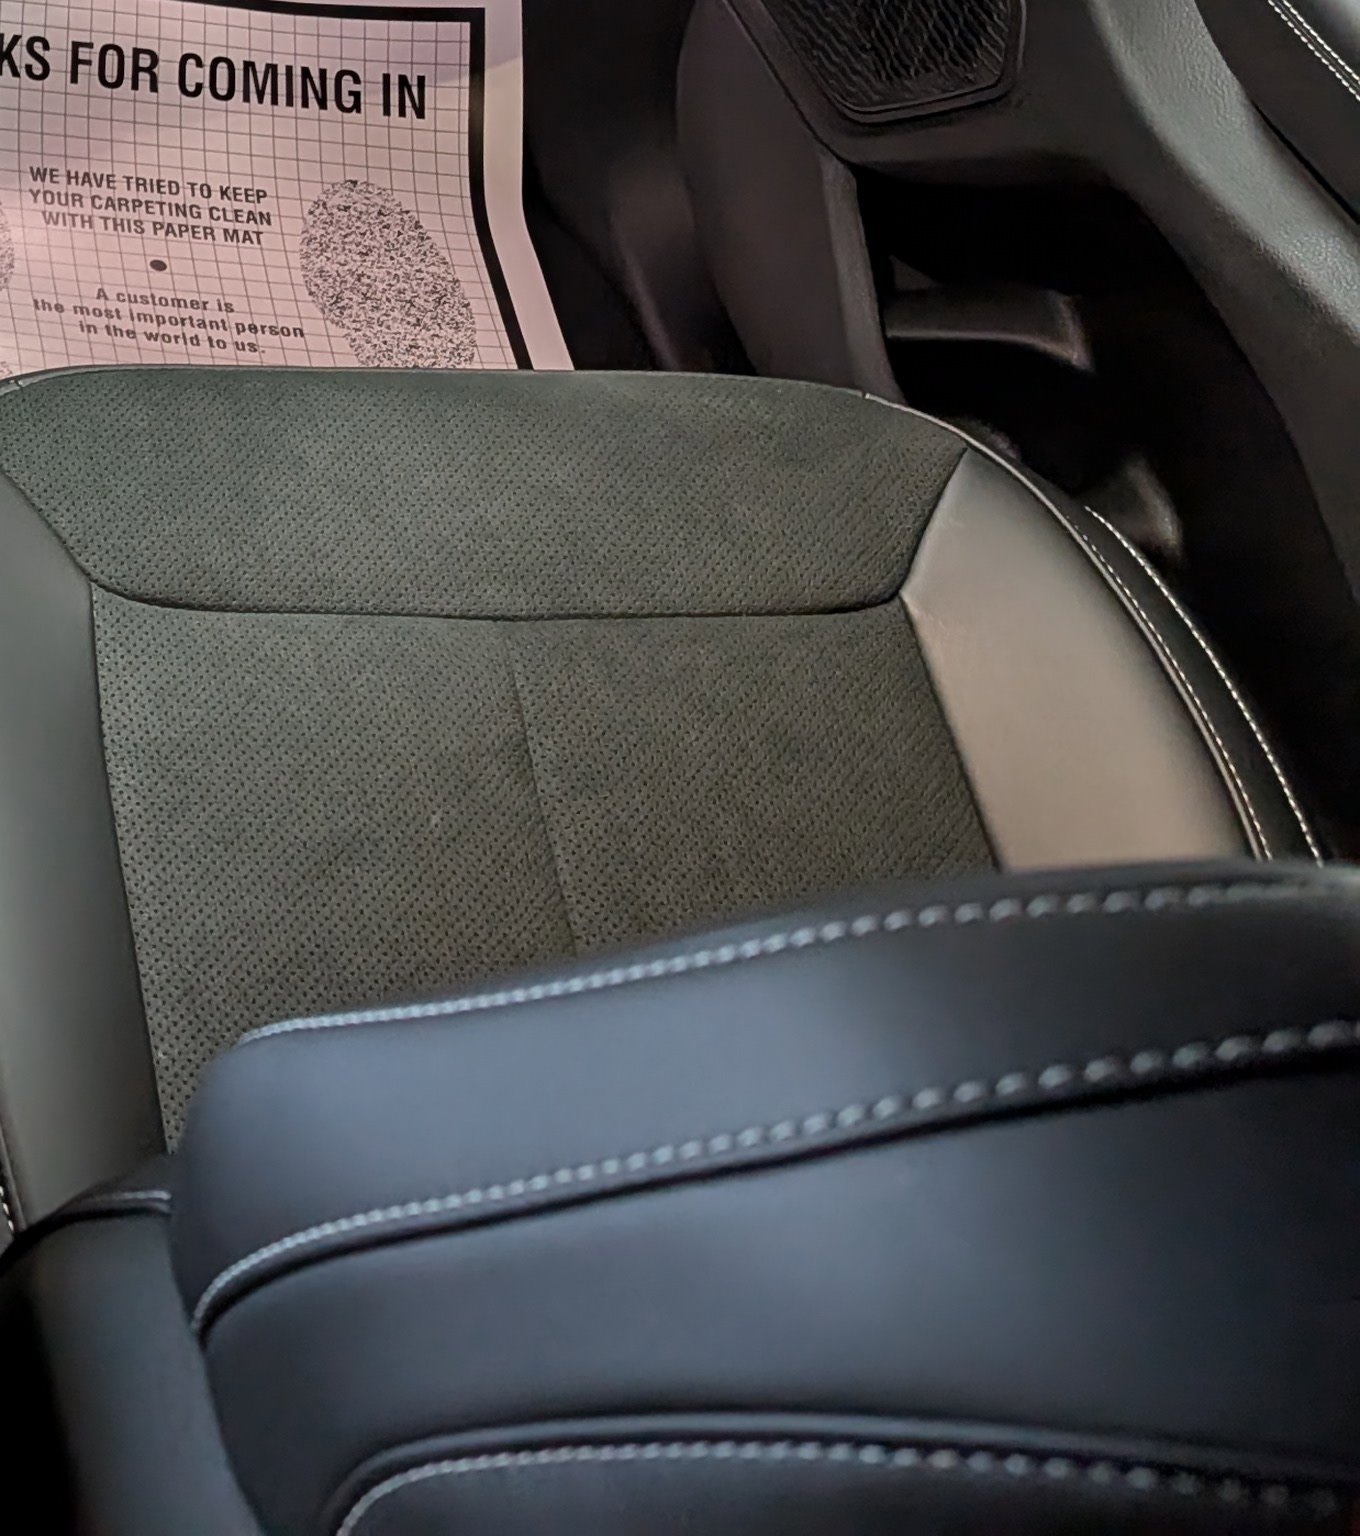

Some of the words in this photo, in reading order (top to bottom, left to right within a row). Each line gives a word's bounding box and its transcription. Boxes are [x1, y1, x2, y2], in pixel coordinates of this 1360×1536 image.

[70, 40, 159, 93] FOR
[178, 52, 362, 114] COMING
[382, 72, 426, 120] IN
[30, 166, 60, 185] WE
[66, 170, 116, 190] HAVE
[123, 175, 180, 196] TRIED
[186, 181, 212, 199] TO
[220, 185, 268, 204] KEEP
[29, 189, 84, 208] YOUR
[91, 195, 202, 219] CARPETING
[209, 206, 272, 226] CLEAN
[42, 210, 93, 230] WITH
[99, 216, 145, 234] THIS
[152, 221, 216, 242] PAPER
[223, 227, 264, 246] MAT
[33, 298, 65, 314] the
[73, 305, 122, 321] most
[129, 310, 229, 332] important
[235, 321, 305, 339] person
[96, 288, 109, 301] A
[116, 291, 210, 312] customer
[217, 298, 235, 313] is
[79, 320, 98, 334] in
[105, 323, 137, 340] the
[143, 329, 201, 348] world
[208, 335, 227, 350] to
[235, 341, 267, 355] us.
